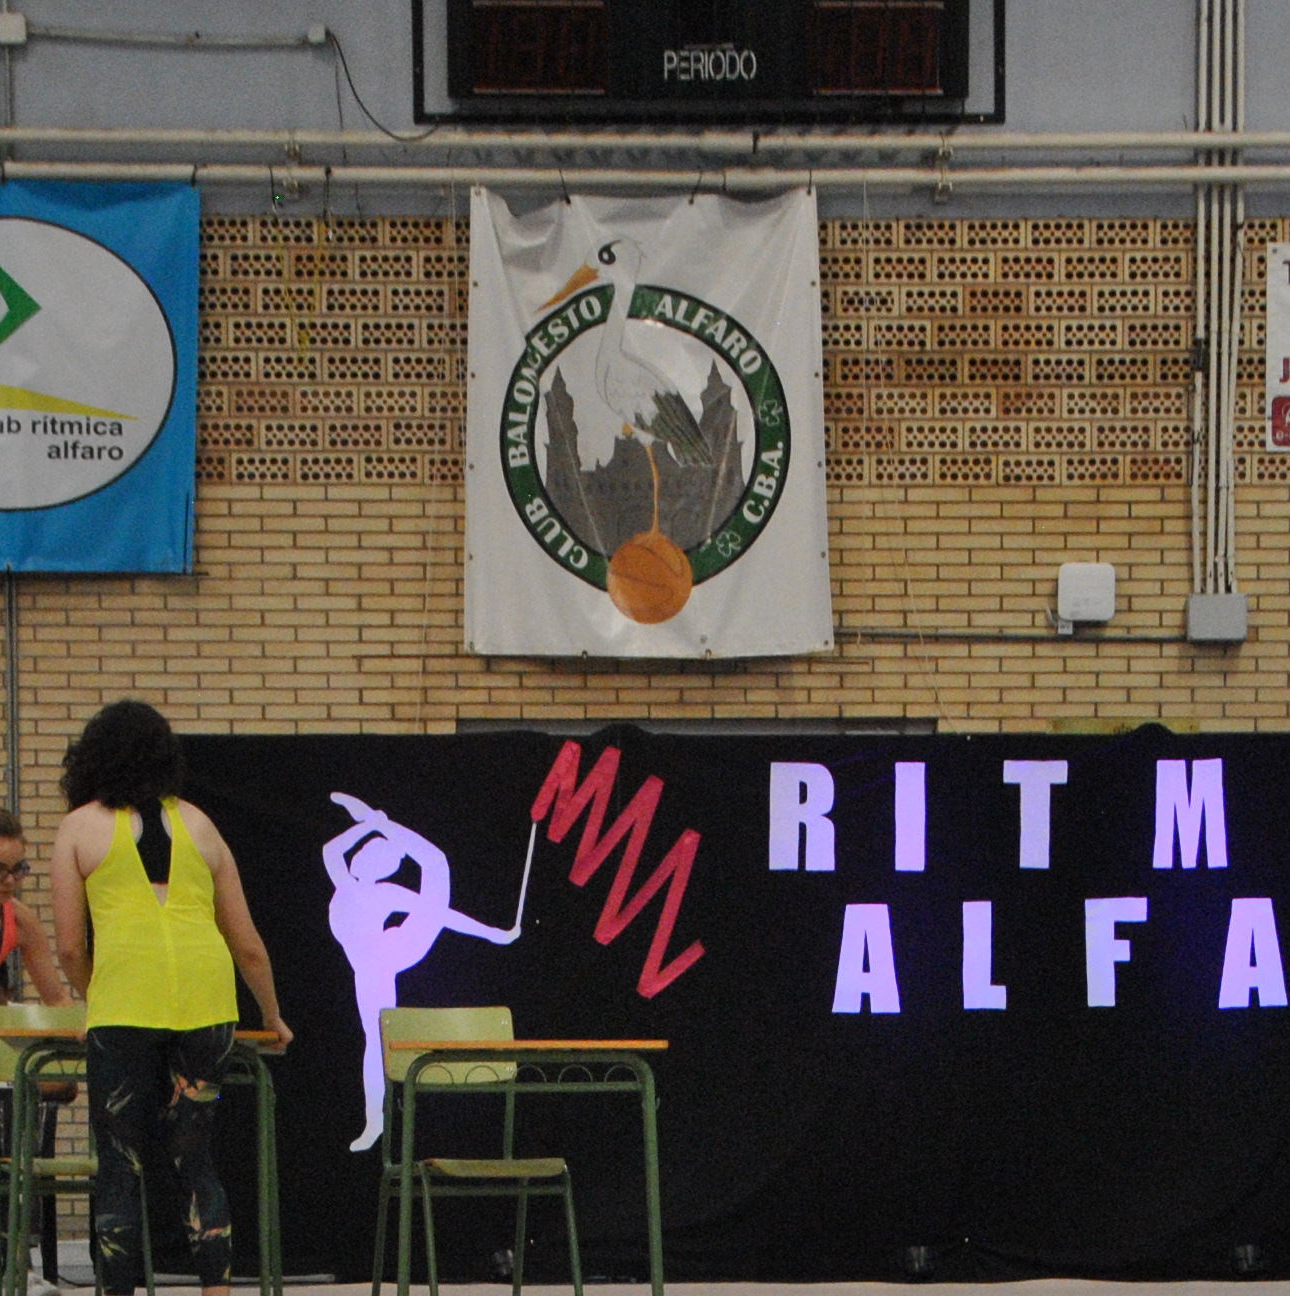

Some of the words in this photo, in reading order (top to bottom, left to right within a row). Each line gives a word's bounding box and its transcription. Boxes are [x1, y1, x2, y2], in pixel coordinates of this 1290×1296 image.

[664, 49, 757, 81] PERIODO
[655, 292, 762, 376] ALFARO
[47, 439, 125, 462] alfaro
[743, 440, 785, 525] C.B.A.
[524, 495, 589, 571] CLUB
